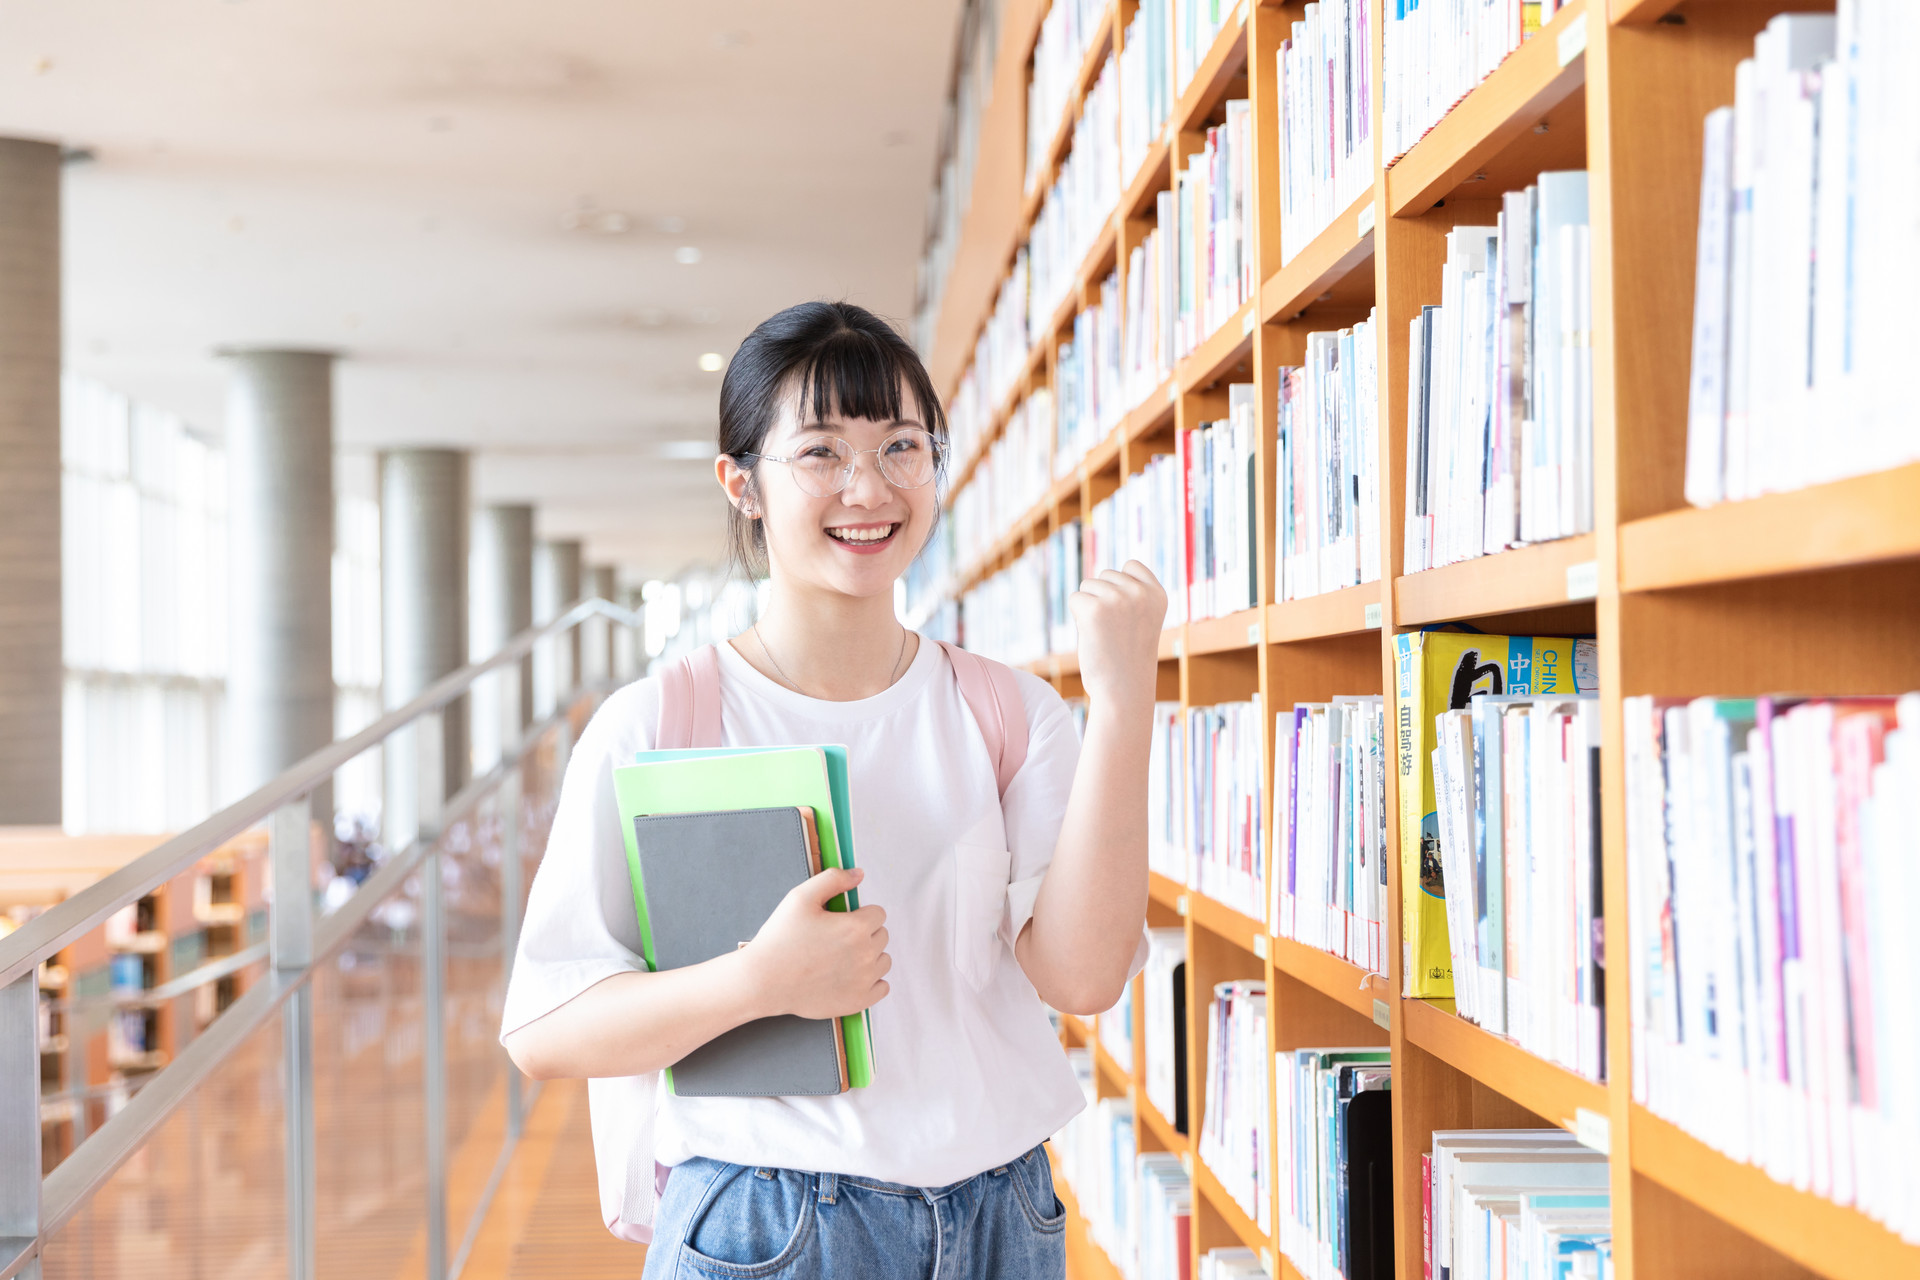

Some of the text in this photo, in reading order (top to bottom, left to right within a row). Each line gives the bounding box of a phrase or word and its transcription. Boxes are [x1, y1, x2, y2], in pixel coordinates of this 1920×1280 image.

[1400, 648, 1411, 692] 中国
[1400, 705, 1412, 776] 自驾游
